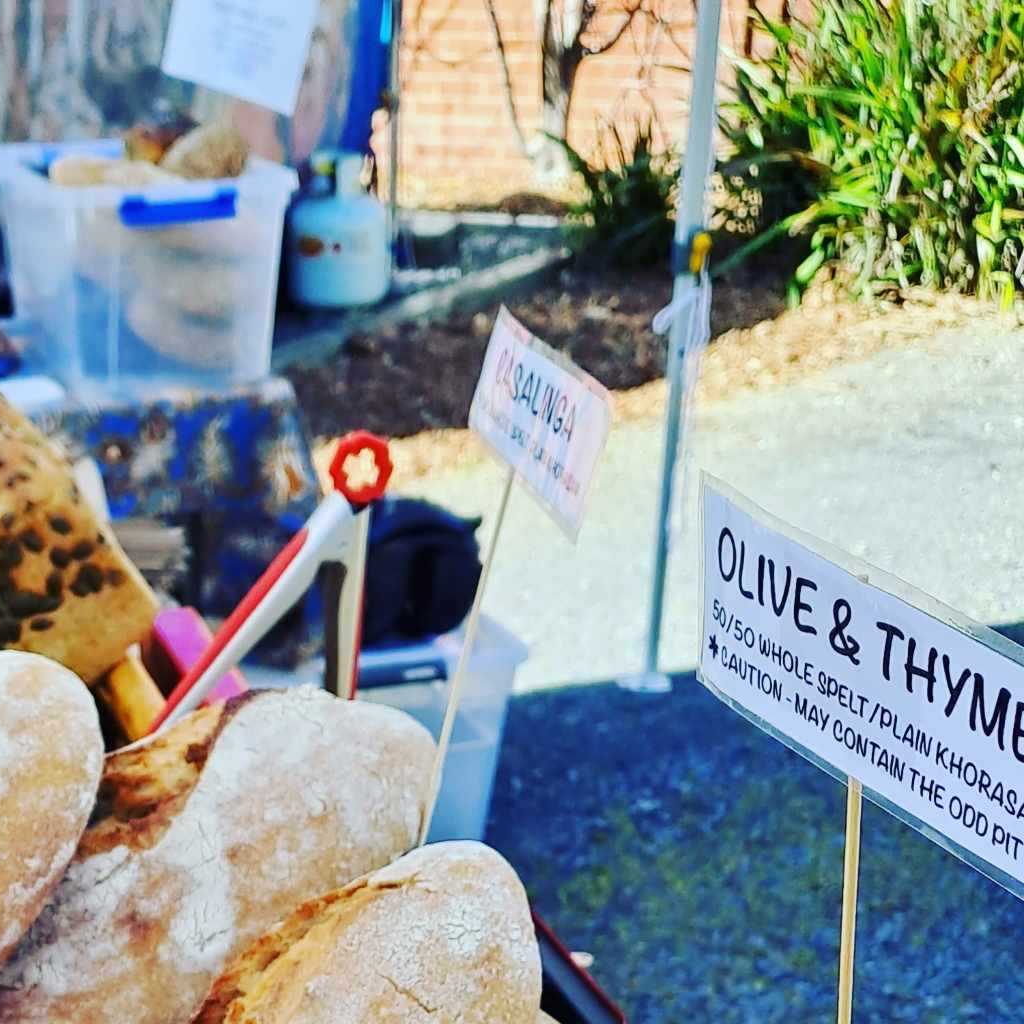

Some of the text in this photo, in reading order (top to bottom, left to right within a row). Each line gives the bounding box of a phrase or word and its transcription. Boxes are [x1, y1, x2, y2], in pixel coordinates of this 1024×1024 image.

[712, 598, 755, 649] 50/50
[758, 633, 814, 686] WHOLE
[717, 526, 818, 636] OLIVE
[829, 598, 861, 666] &
[794, 692, 830, 732] MAY
[832, 719, 906, 783] CONTAIN
[909, 767, 946, 810] THE
[948, 796, 989, 838] ODD
[992, 822, 1024, 860] PIT
